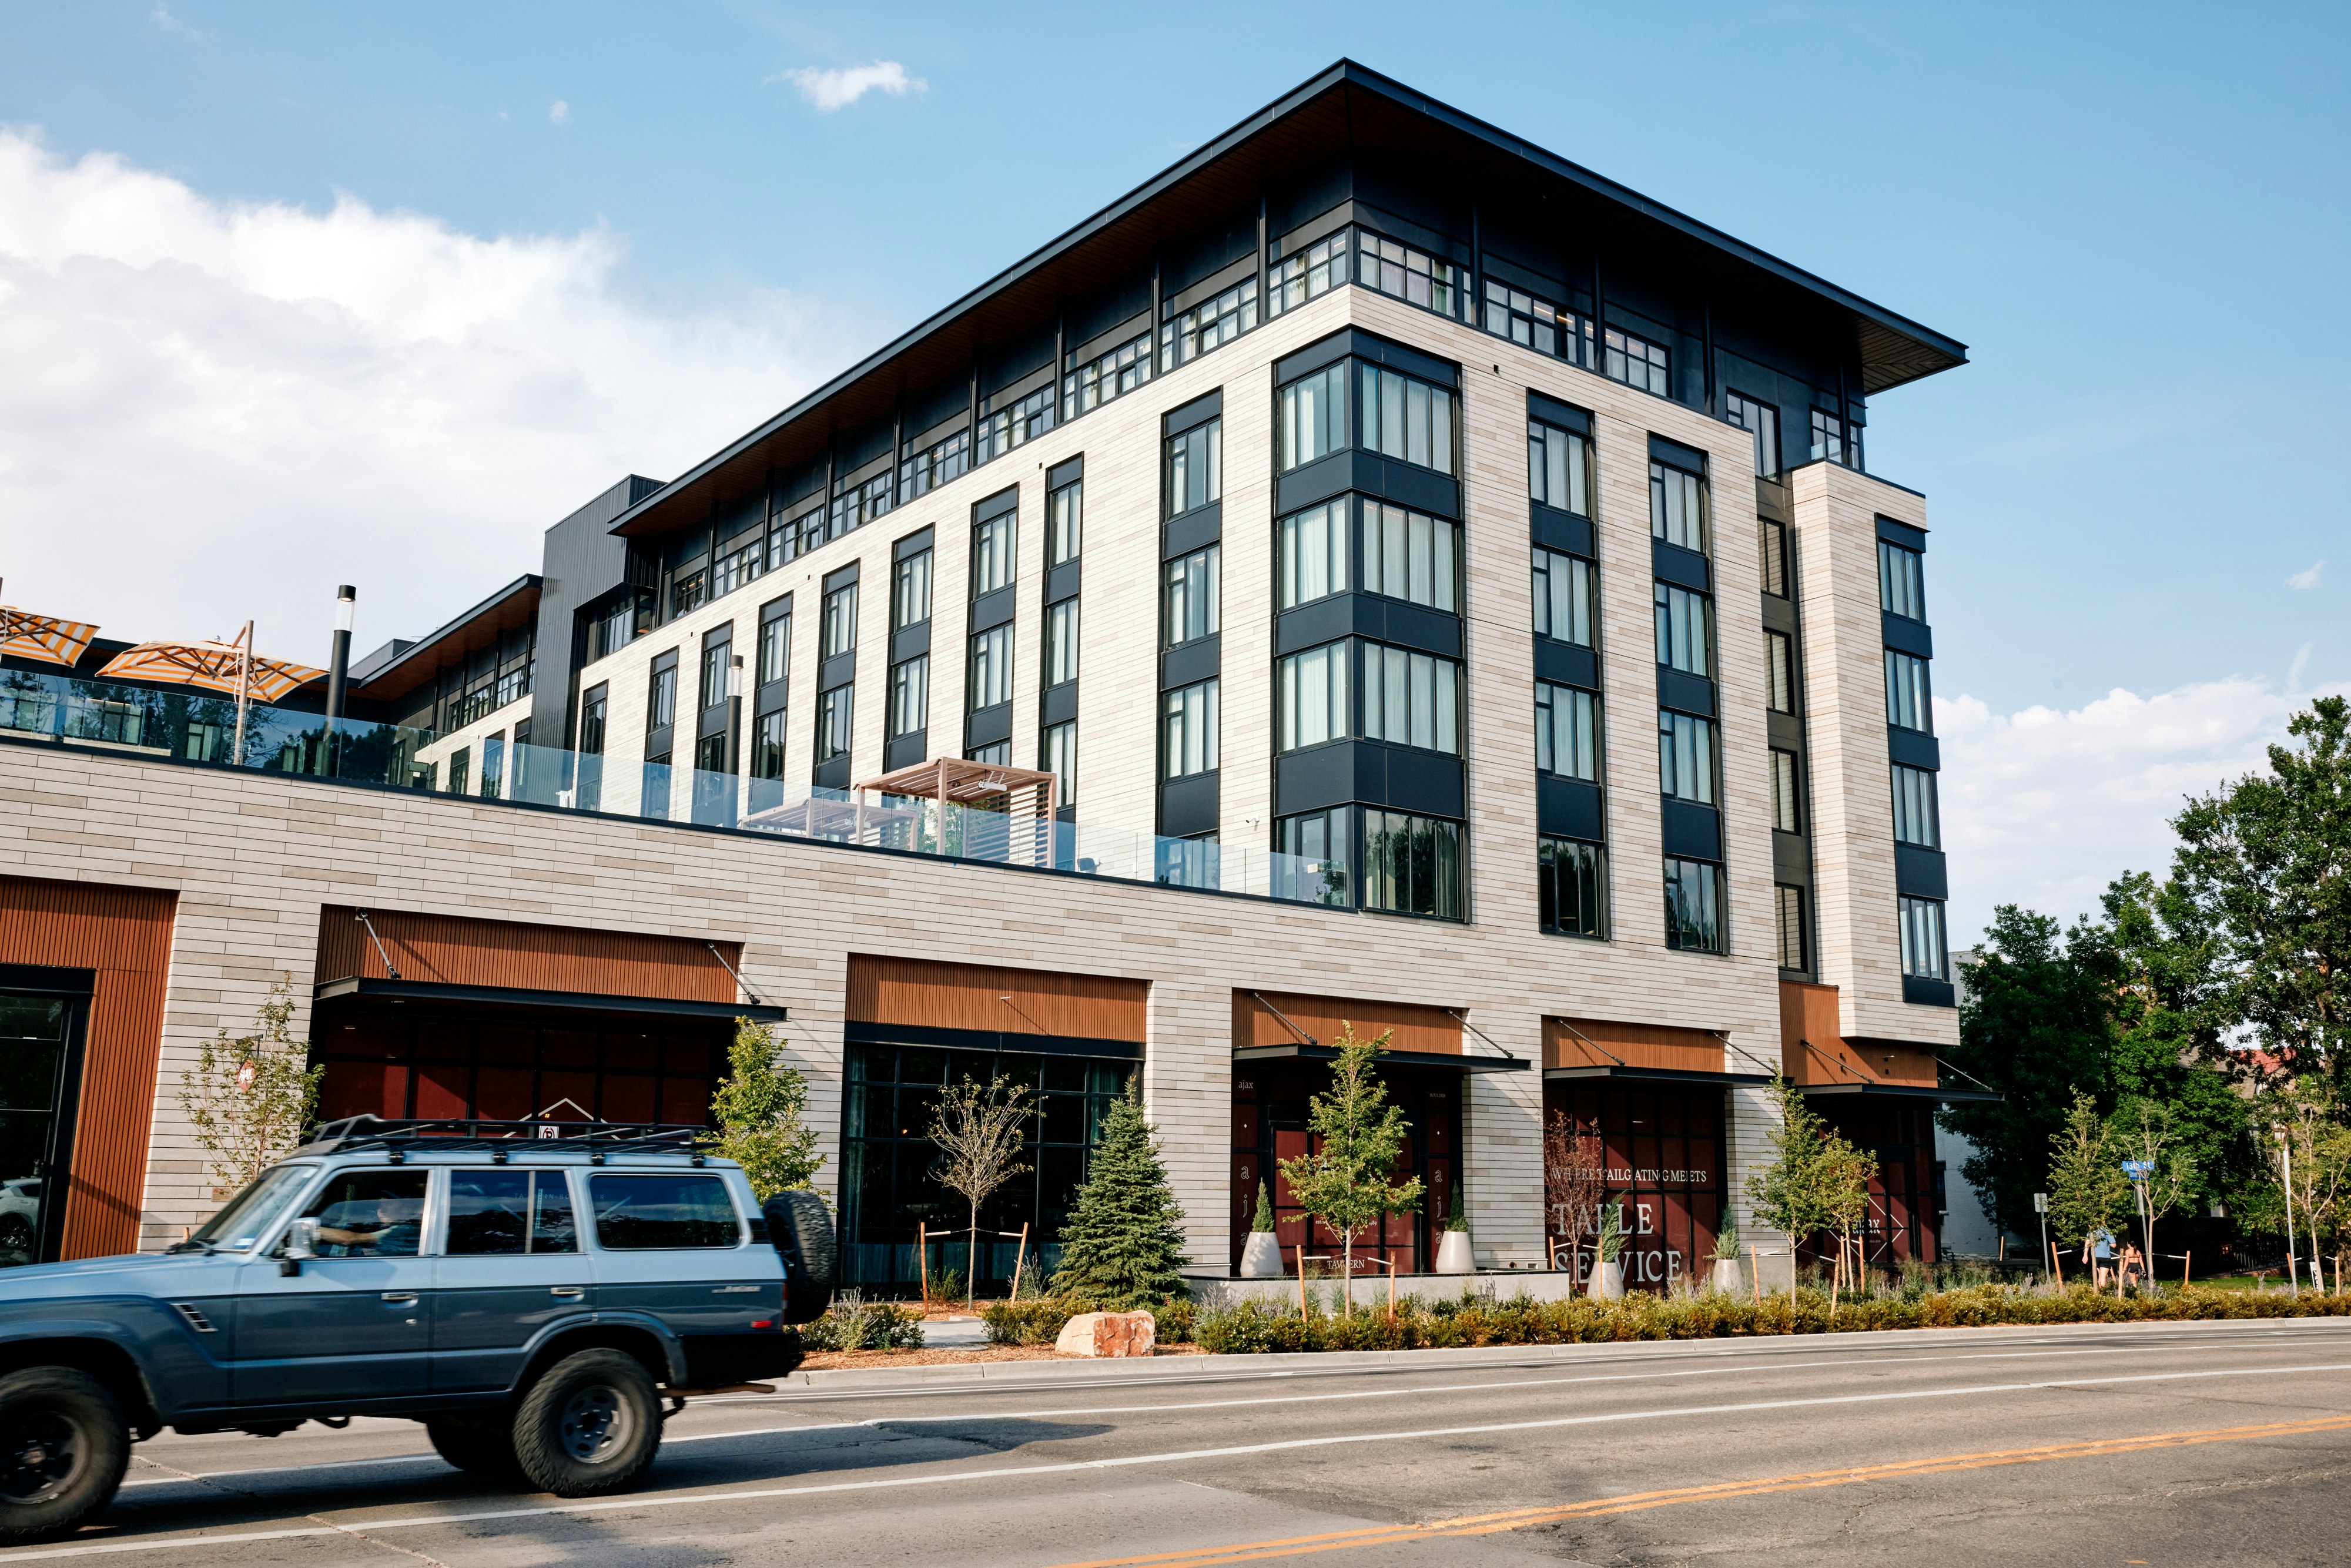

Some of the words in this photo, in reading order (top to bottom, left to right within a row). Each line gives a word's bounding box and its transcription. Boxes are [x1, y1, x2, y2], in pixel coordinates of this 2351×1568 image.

[1238, 1080, 1253, 1091] ajax
[1596, 1168, 1669, 1182] TAILGATING
[1670, 1170, 1707, 1182] MEETS
[1555, 1250, 1682, 1284] SEVICE
